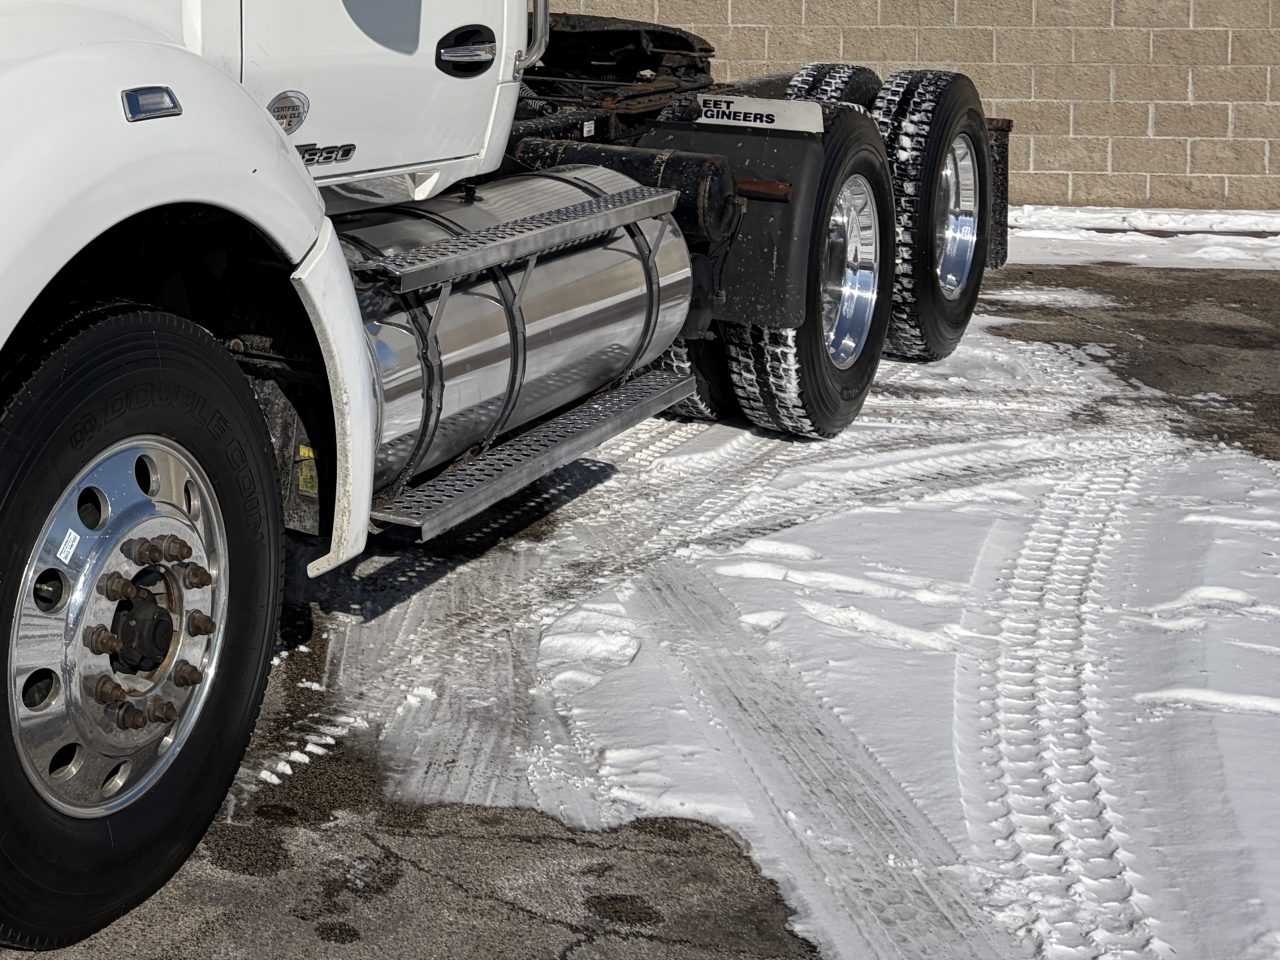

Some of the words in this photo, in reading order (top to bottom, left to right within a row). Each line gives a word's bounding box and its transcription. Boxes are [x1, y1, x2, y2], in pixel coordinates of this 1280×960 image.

[273, 105, 300, 113] CERTIFIED
[104, 382, 230, 440] DOUBLE
[225, 437, 265, 546] COIN
